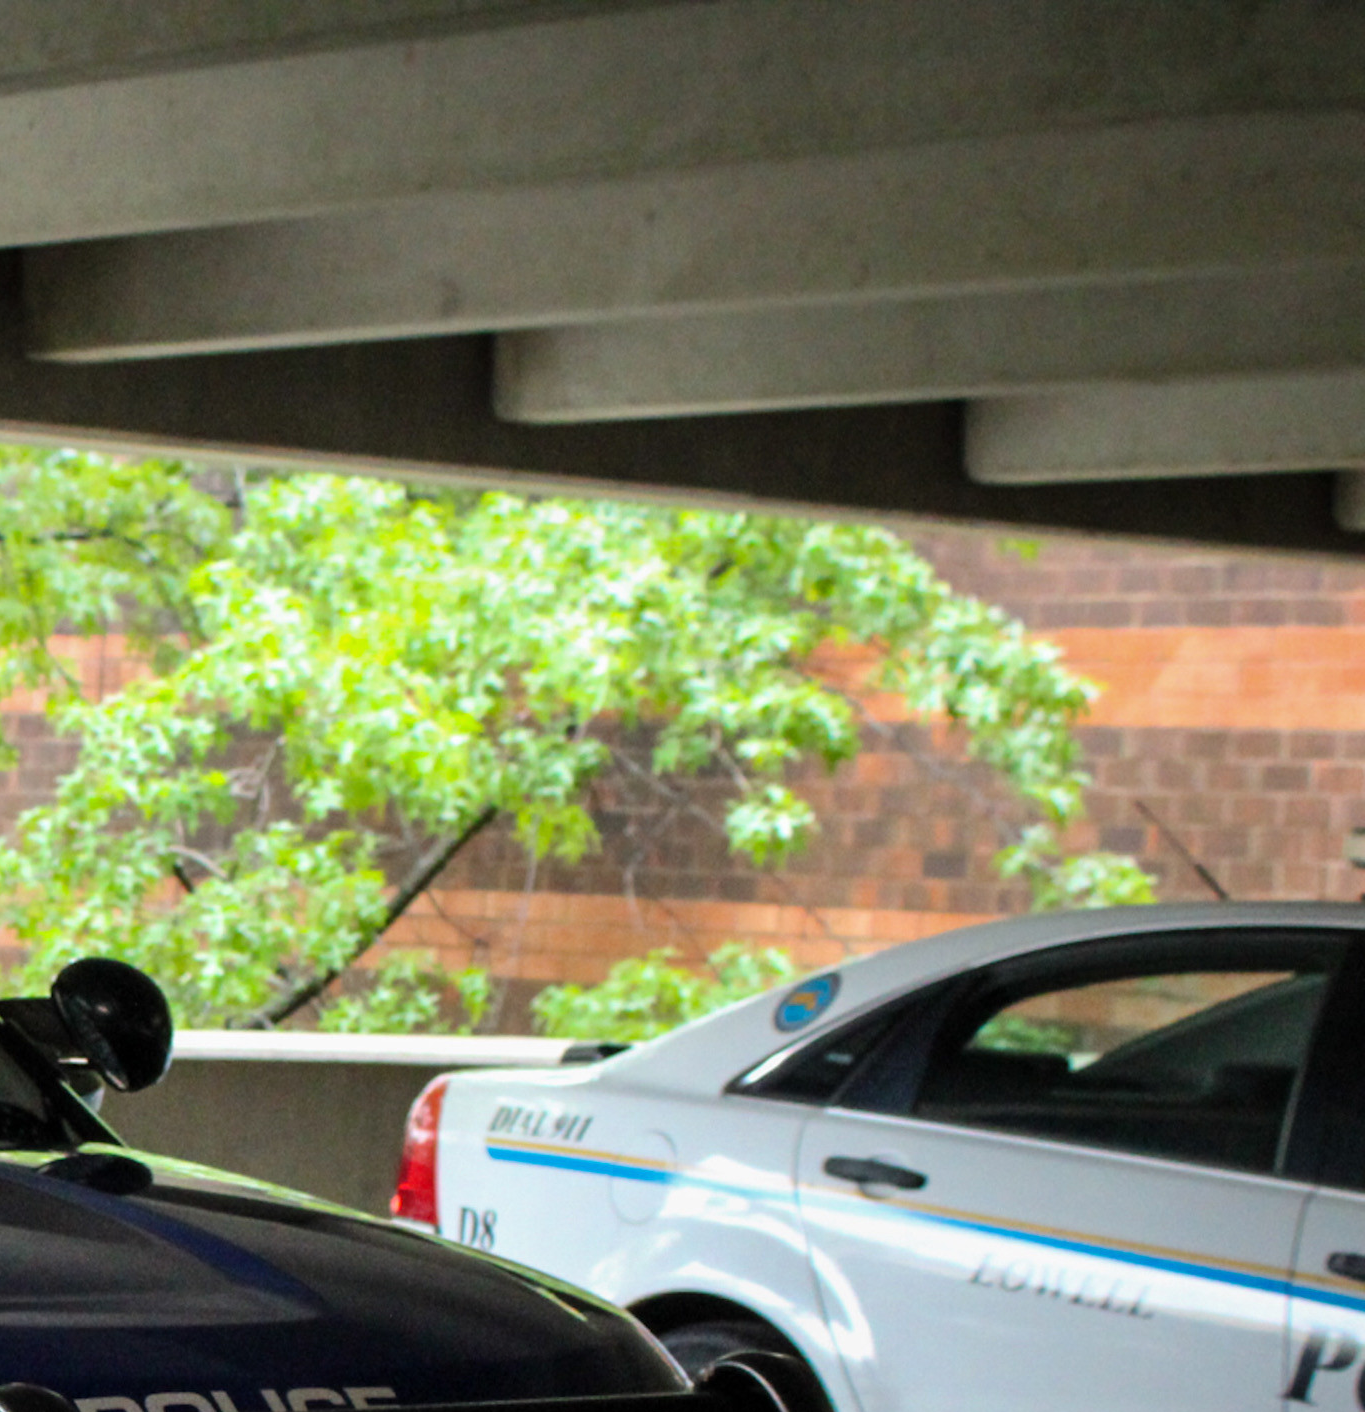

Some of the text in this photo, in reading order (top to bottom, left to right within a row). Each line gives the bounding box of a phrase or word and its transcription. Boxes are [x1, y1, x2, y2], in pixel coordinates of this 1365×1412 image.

[488, 1105, 594, 1143] DIAL 911
[459, 1206, 498, 1251] D8
